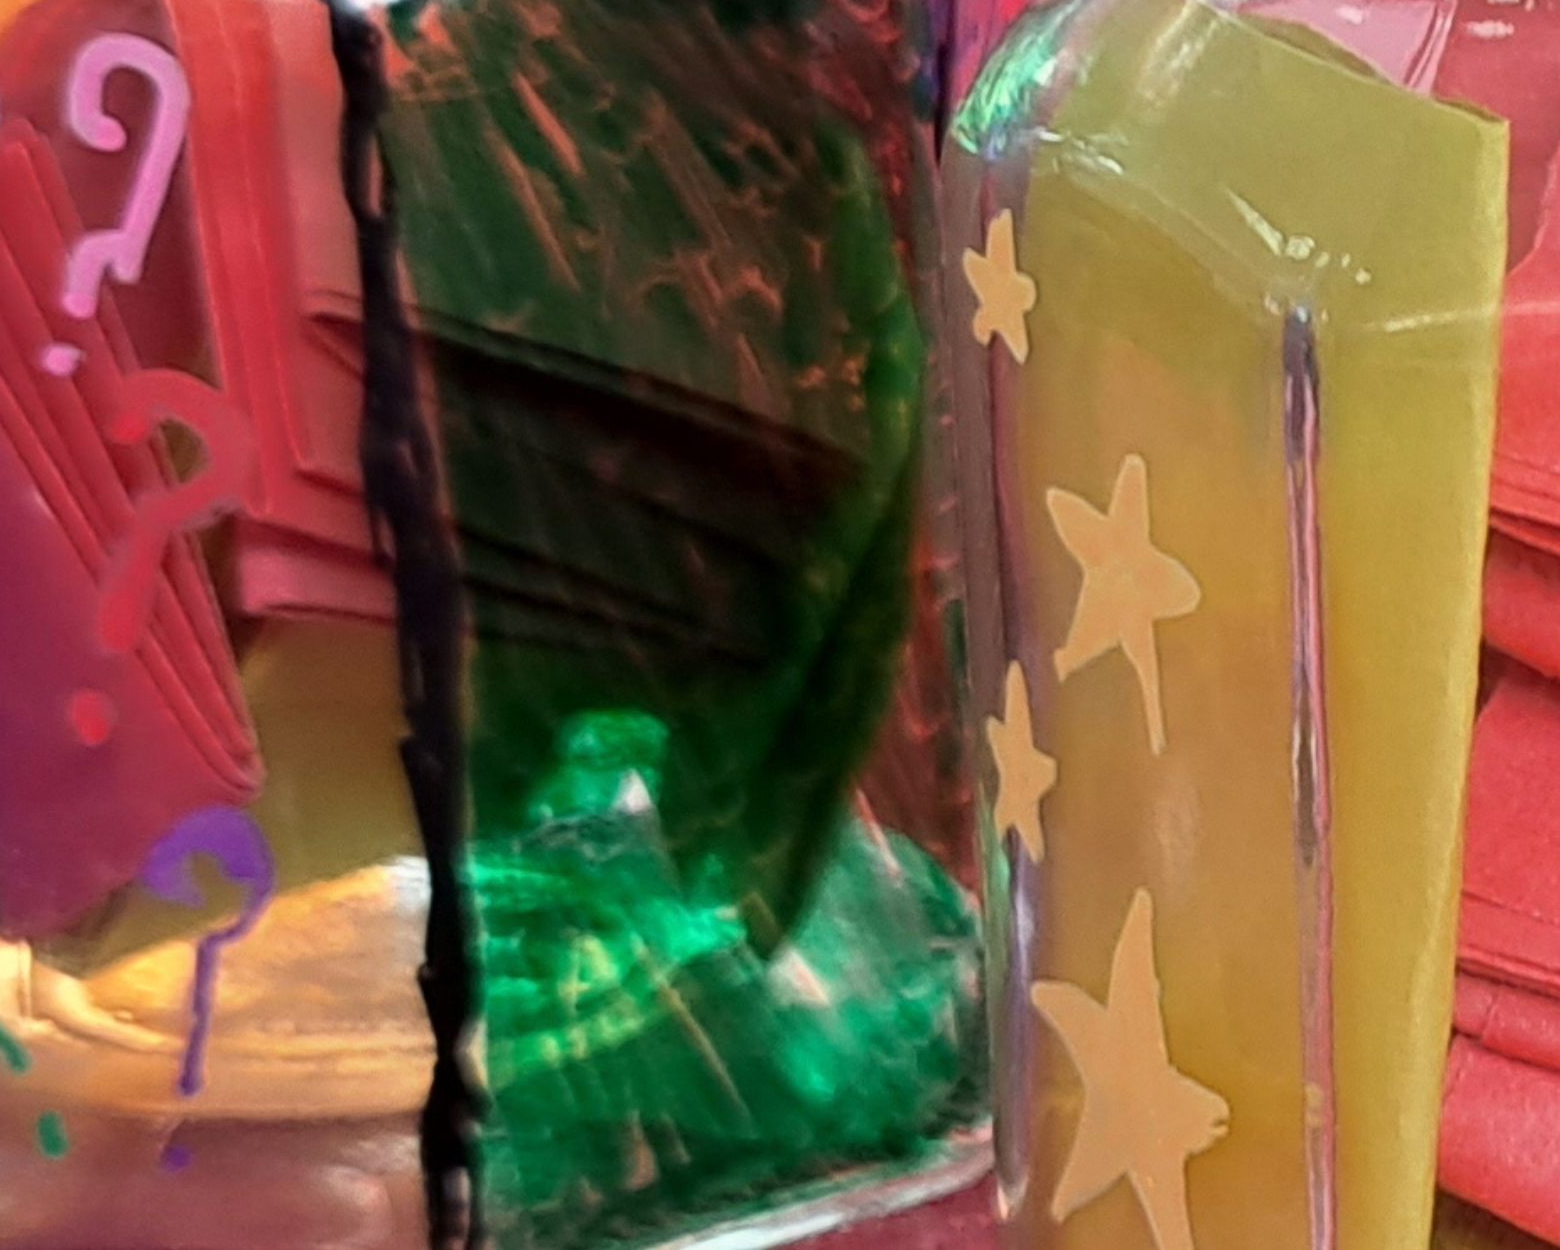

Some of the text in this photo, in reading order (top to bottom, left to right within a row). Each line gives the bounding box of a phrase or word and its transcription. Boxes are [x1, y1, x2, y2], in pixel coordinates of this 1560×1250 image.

[43, 35, 188, 375] ?
[68, 368, 258, 746] ?
[142, 805, 274, 1169] ?
